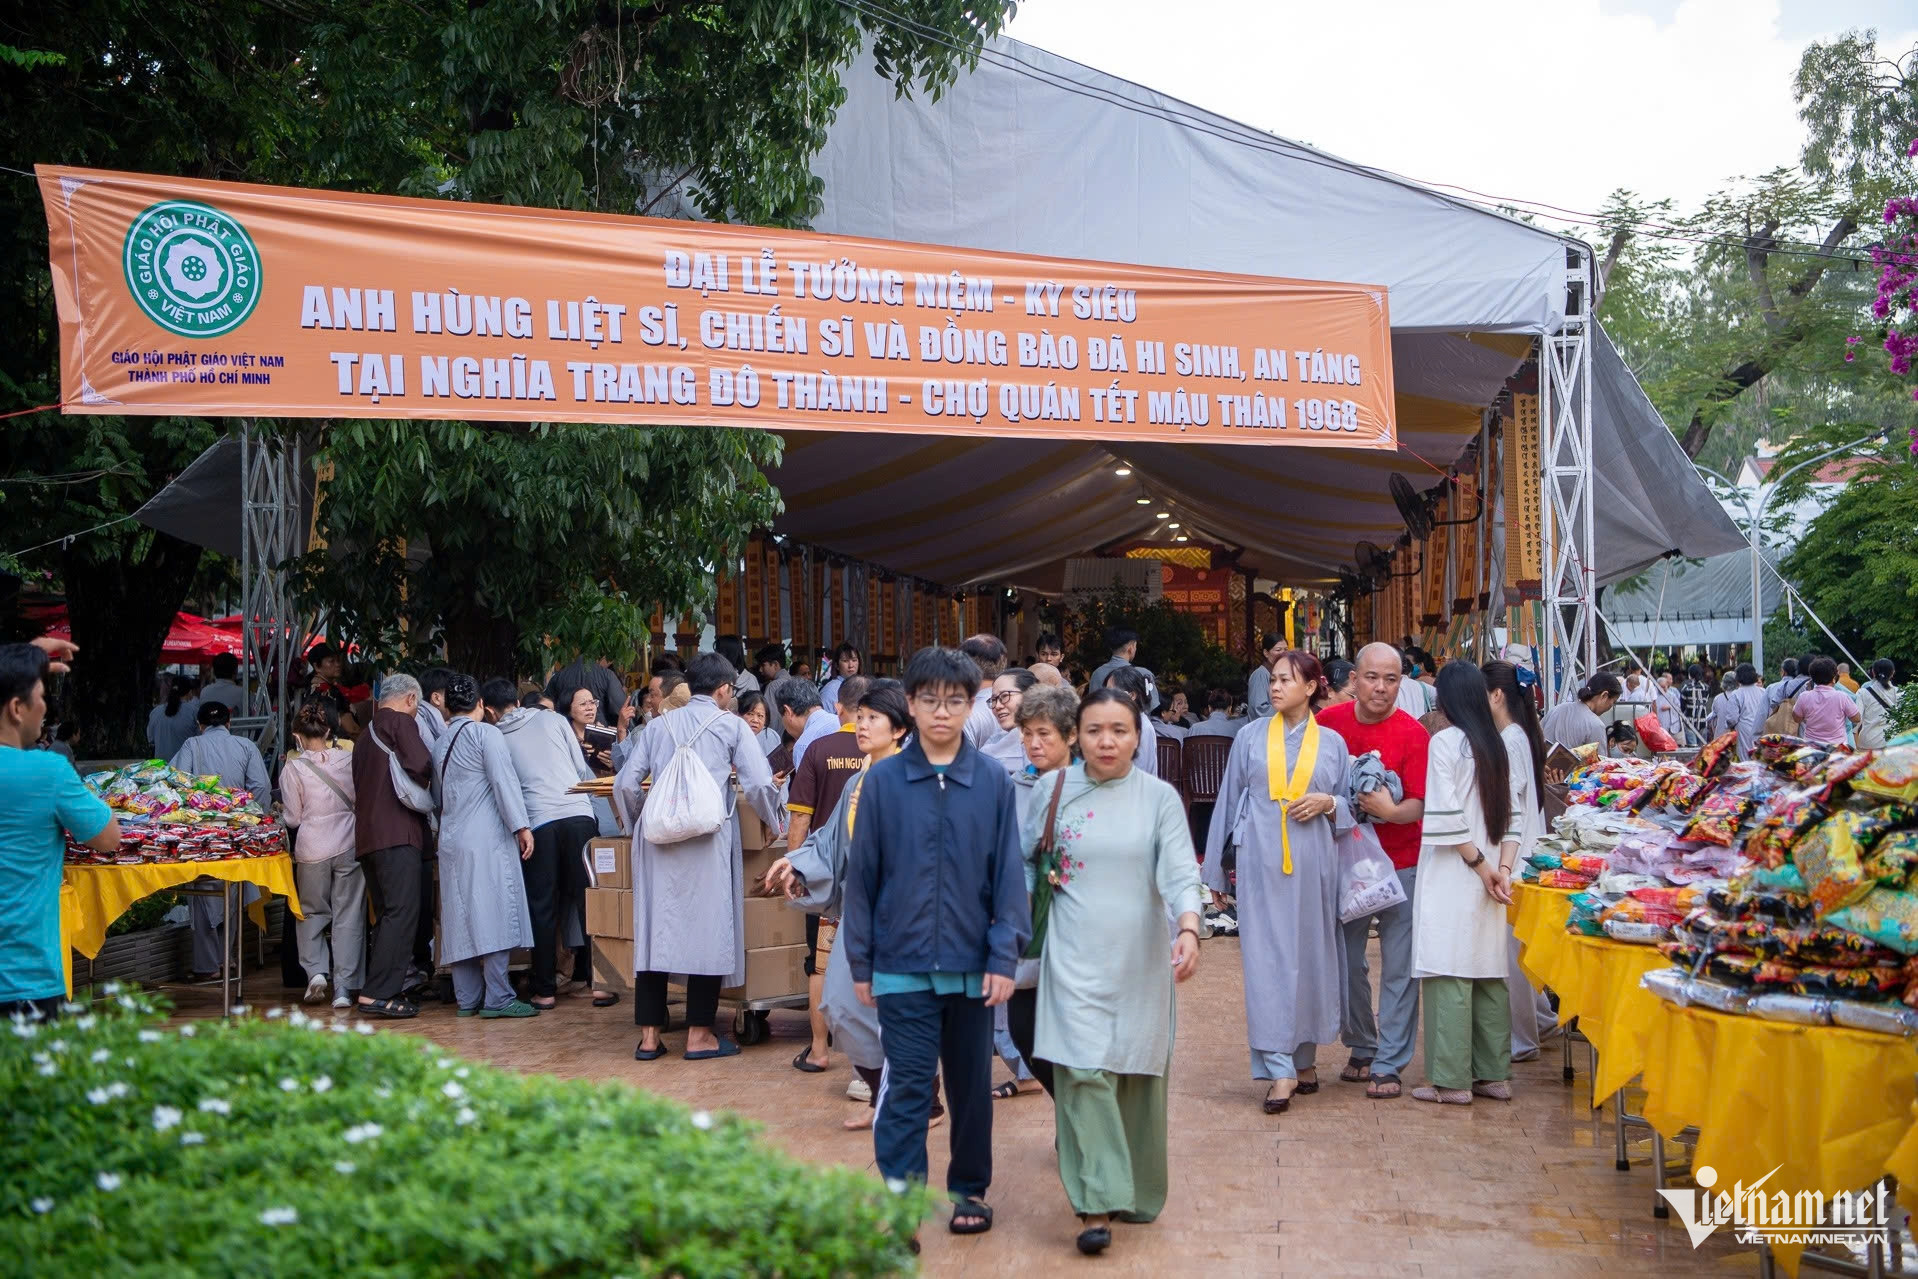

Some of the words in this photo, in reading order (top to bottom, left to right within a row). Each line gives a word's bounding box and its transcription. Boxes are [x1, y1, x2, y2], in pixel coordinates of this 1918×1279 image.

[134, 238, 154, 284] GIÁO
[149, 214, 178, 239] HỘI
[183, 213, 231, 241] PHẬT
[231, 244, 252, 288] GIÁO
[664, 250, 729, 297] ĐẠI
[741, 247, 778, 296] LỄ
[788, 257, 904, 305] TƯỞNG
[914, 270, 994, 316] NIỆM
[1025, 280, 1065, 317] KỲ
[1072, 283, 1137, 323] SIÊU
[160, 299, 195, 324] VIỆT
[198, 303, 233, 324] NAM
[301, 285, 397, 331] ANH
[411, 288, 533, 338] HÙNG
[547, 295, 626, 349] LIỆT
[638, 302, 688, 351] SĨ,
[699, 304, 808, 354] CHIẾN
[818, 315, 854, 357] SĨ
[863, 318, 910, 360] VÀ
[918, 316, 1008, 366] ĐỒNG
[1017, 329, 1079, 371] BÀO
[1087, 334, 1129, 373] ĐÃ
[1135, 340, 1166, 374] HI
[1173, 342, 1247, 382] SINH,
[1253, 348, 1288, 381] AN
[1295, 348, 1361, 385] TÁNG
[111, 349, 140, 365] GIÁO
[143, 350, 165, 367] HỘI
[167, 351, 197, 367] PHẬT
[201, 352, 227, 367] GIÁO
[231, 352, 257, 369] VIỆT
[259, 355, 284, 367] NAM
[128, 369, 168, 383] THÀNH
[172, 368, 196, 384] PHỐ
[200, 368, 216, 384] HỒ
[219, 369, 238, 384] CHÍ
[241, 372, 270, 385] MINH
[330, 352, 405, 404] TẠI
[420, 353, 556, 401] NGHĨA
[567, 361, 697, 405] TRANG
[708, 364, 760, 408] ĐÔ
[771, 369, 888, 413] THÀNH
[922, 377, 989, 424] CHỢ
[1000, 381, 1081, 424] QUÁN
[1089, 378, 1139, 423] TẾT
[1147, 386, 1209, 431] MẬU
[1216, 391, 1287, 430] THÂN
[1294, 399, 1358, 432] 1968
